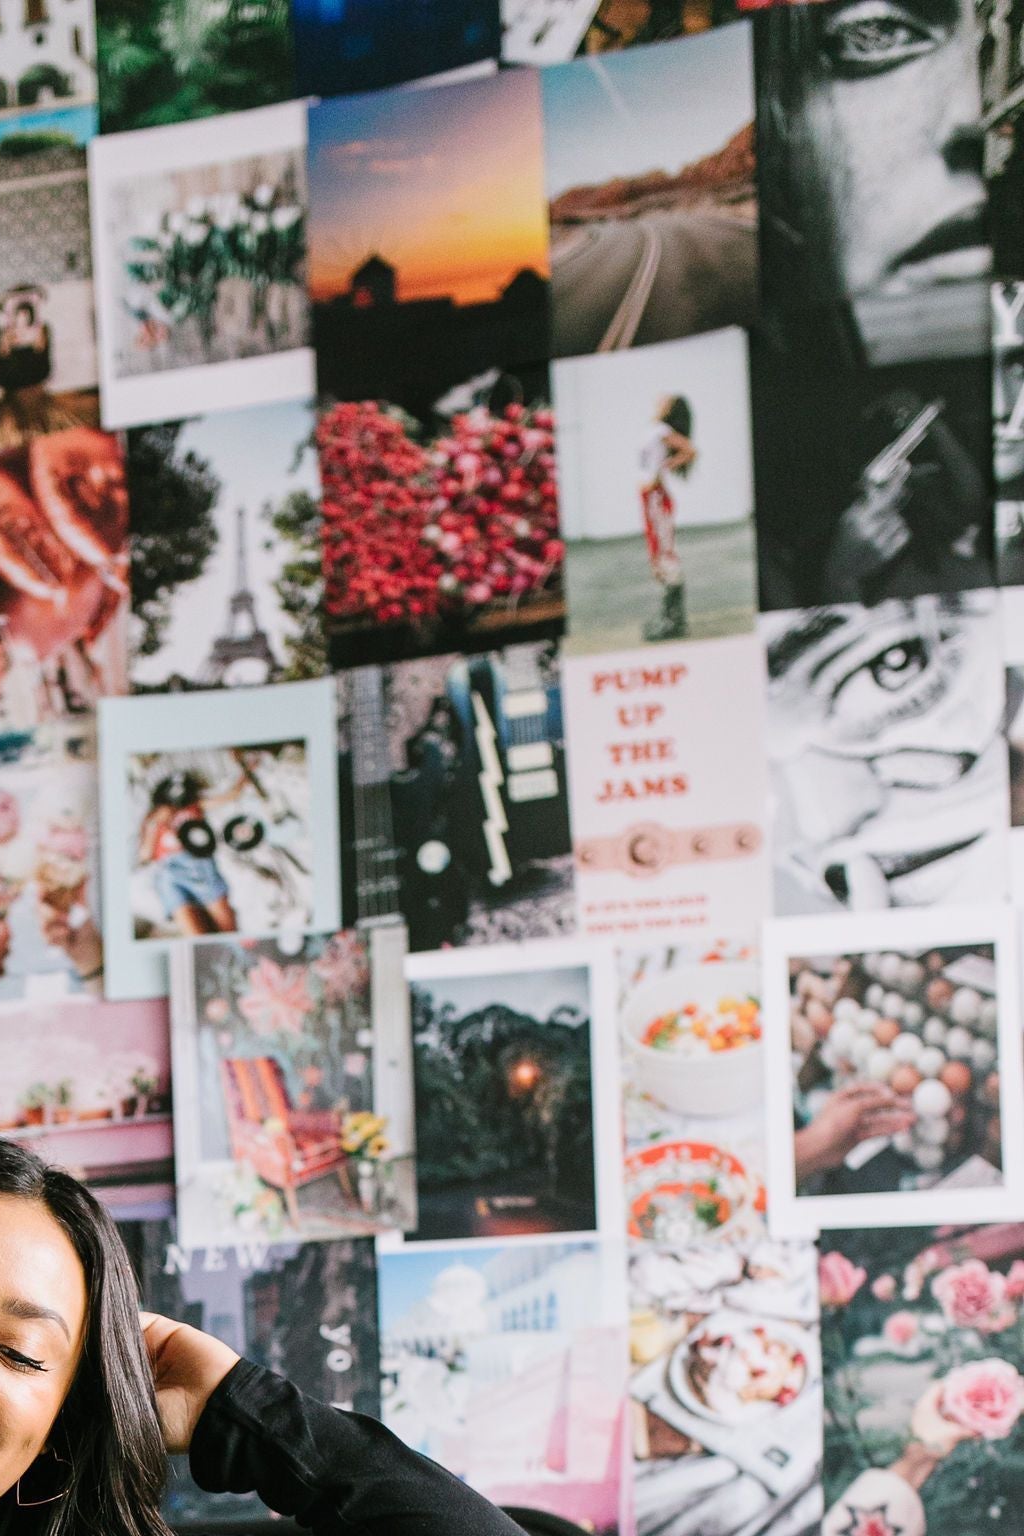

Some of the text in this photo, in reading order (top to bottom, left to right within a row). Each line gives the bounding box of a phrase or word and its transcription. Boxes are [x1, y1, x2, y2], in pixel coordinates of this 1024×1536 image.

[592, 663, 688, 695] PUMP
[617, 702, 664, 728] UP
[608, 737, 676, 765] THE
[595, 773, 690, 804] JAMS
[162, 1241, 270, 1275] NEW
